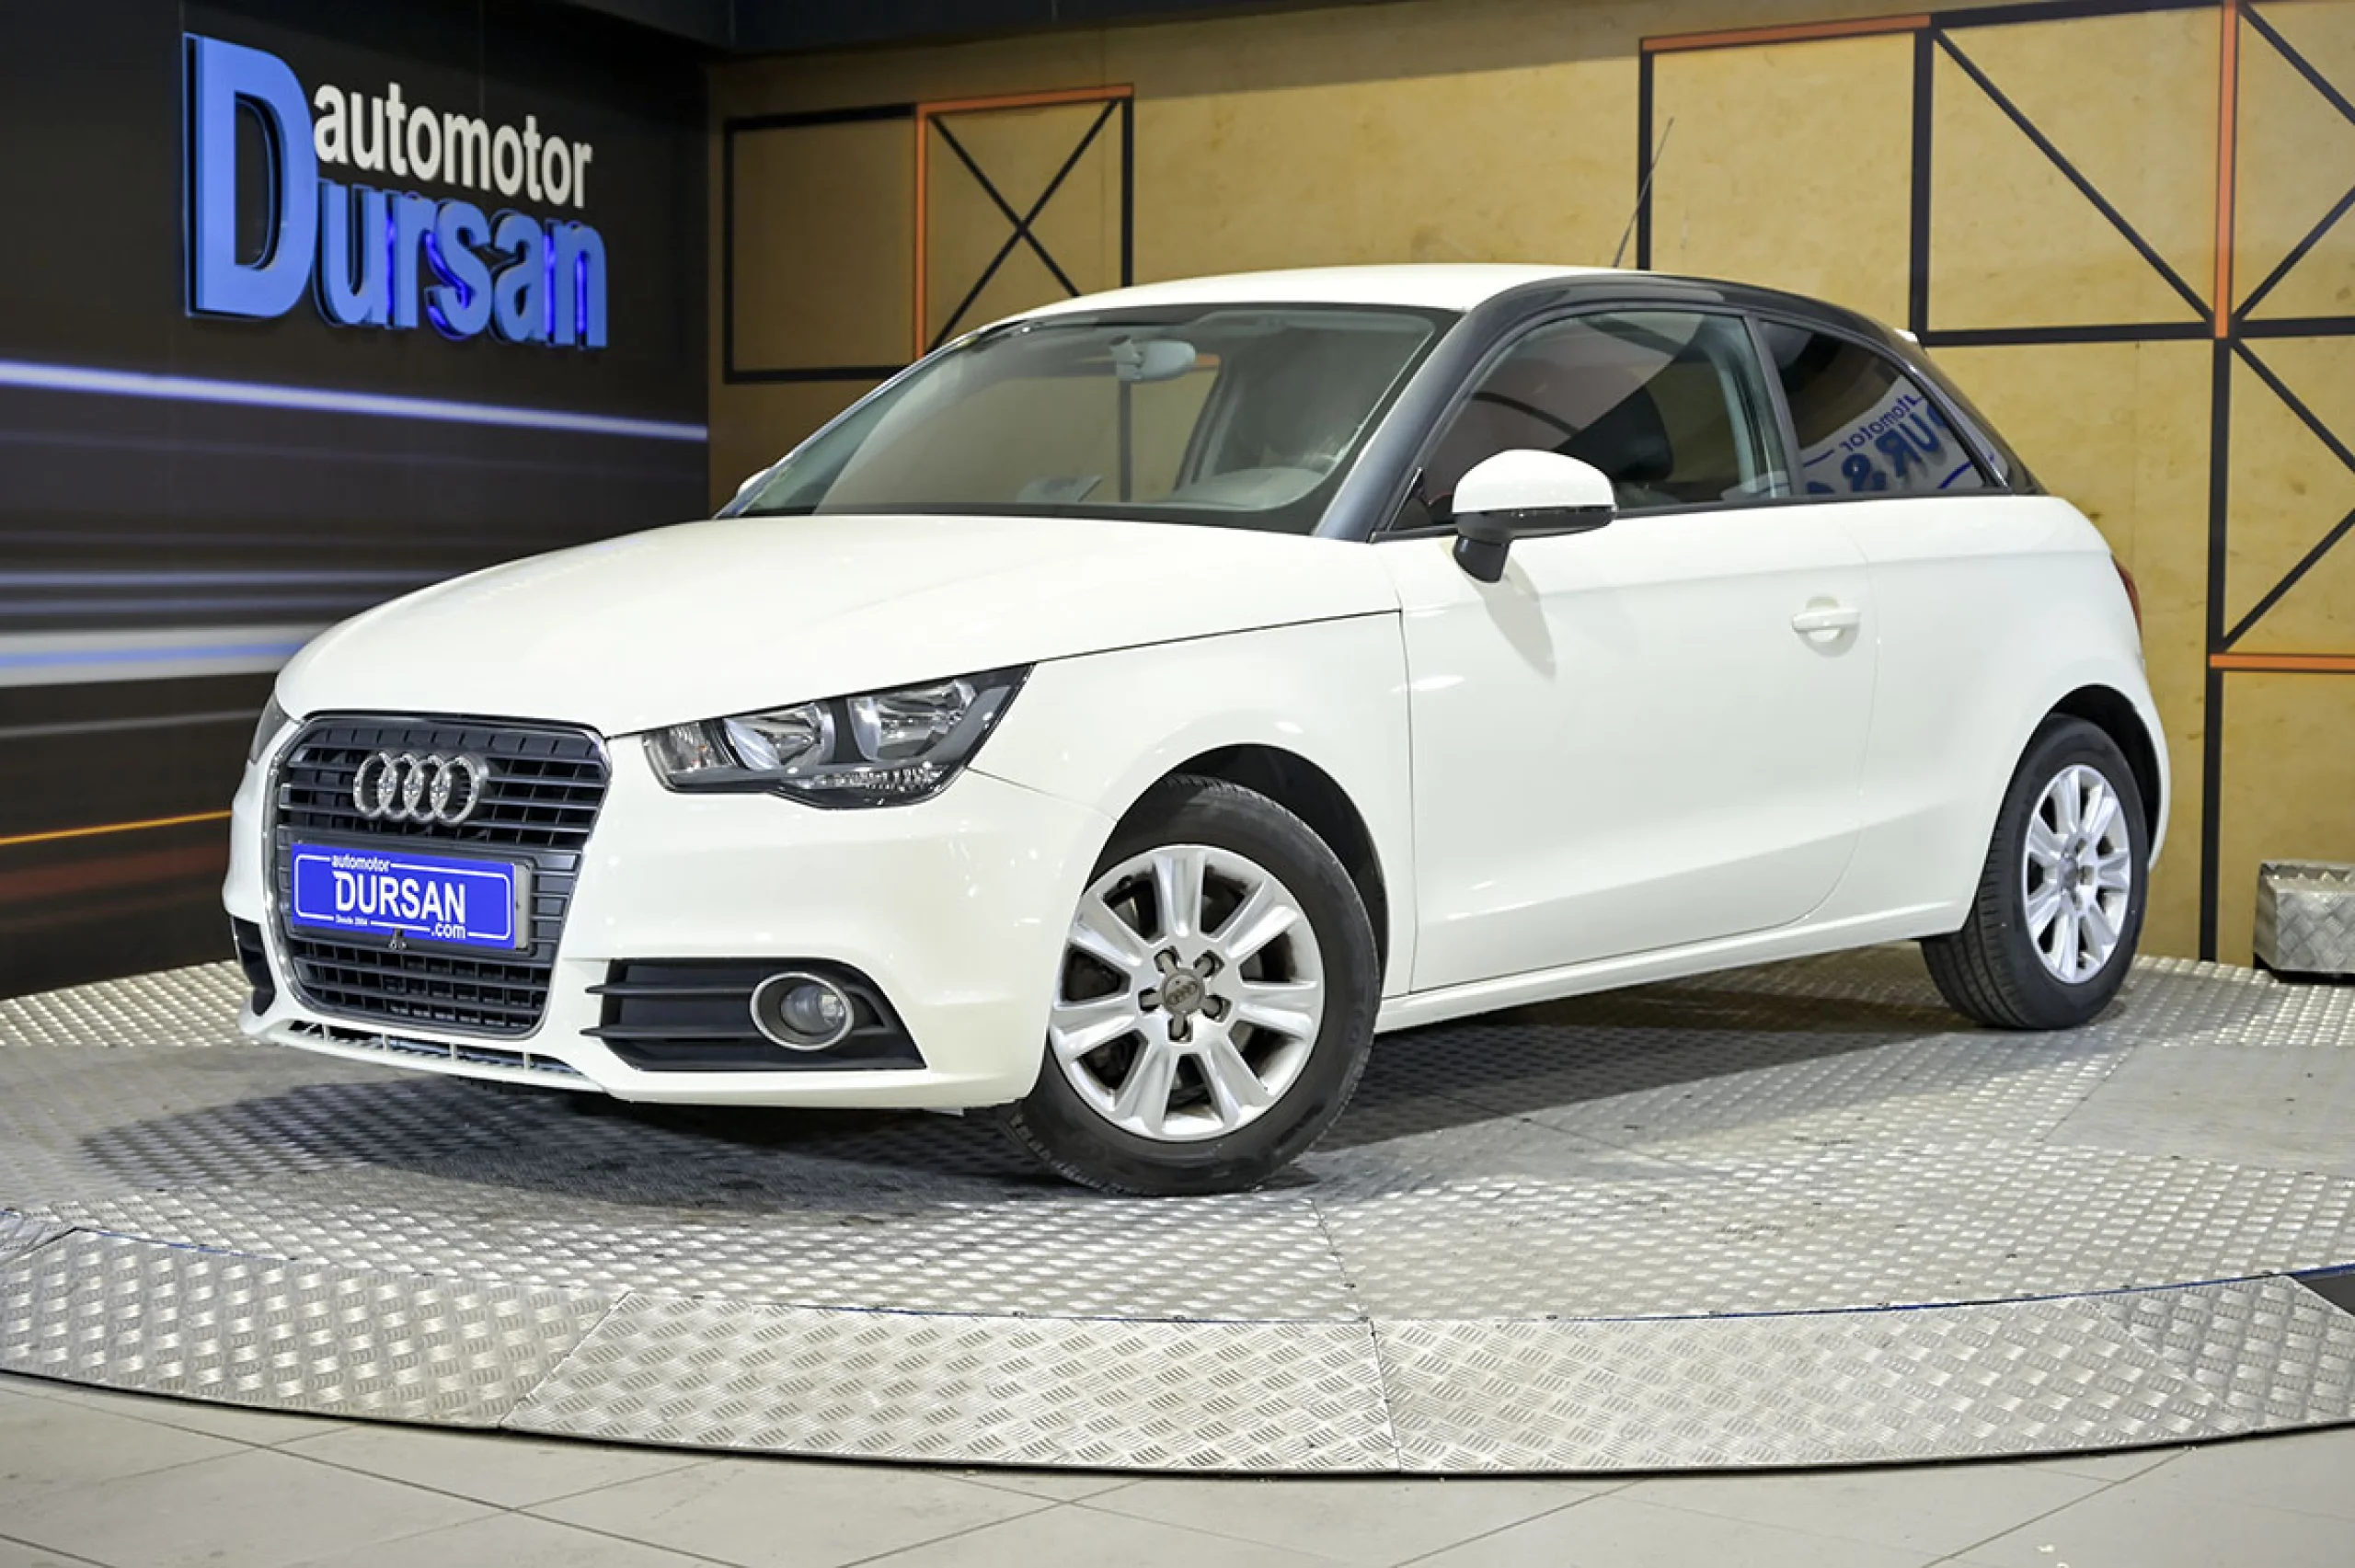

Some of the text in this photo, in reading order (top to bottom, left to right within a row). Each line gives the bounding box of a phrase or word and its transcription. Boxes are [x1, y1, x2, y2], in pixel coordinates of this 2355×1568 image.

[314, 82, 593, 209] automotor
[182, 30, 608, 350] Dursan
[331, 853, 391, 873] automotor
[332, 870, 466, 923] DURSAN
[431, 921, 466, 940] .com
